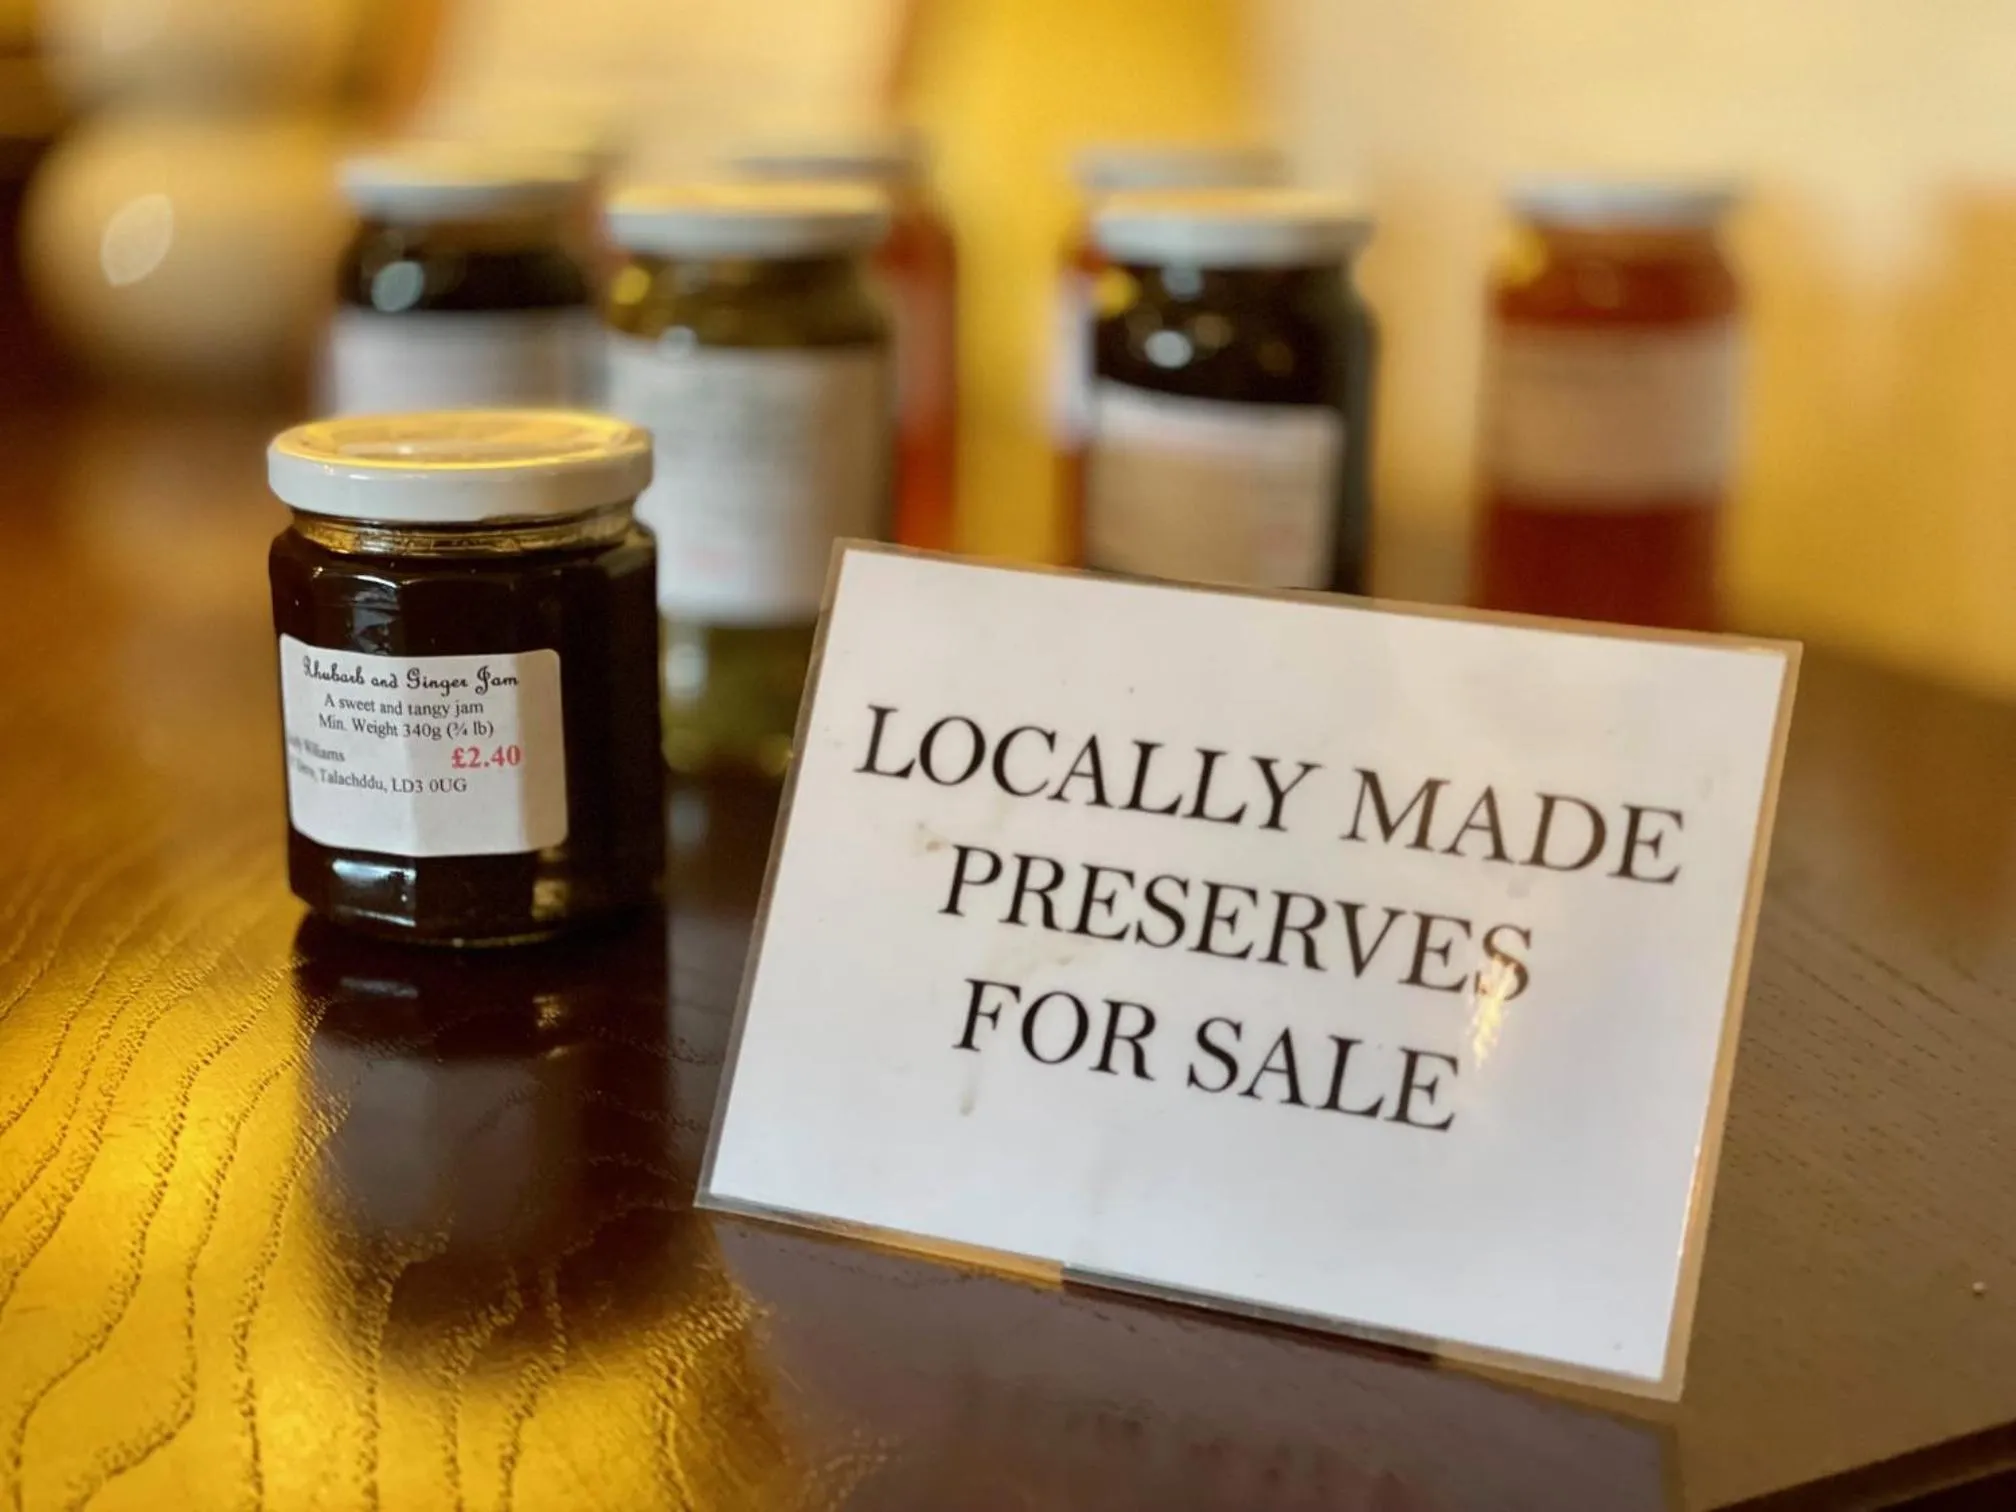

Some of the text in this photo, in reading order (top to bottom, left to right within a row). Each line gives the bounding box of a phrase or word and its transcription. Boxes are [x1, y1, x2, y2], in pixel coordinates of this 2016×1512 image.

[303, 655, 520, 696] Rhubarb and Ginger Jam
[324, 693, 484, 719] A sweet and tangy jam
[319, 713, 347, 731] Min.
[352, 717, 399, 740] Weight
[403, 723, 442, 741] 340g
[473, 720, 494, 739] lb)
[451, 744, 522, 769] £2.40
[391, 778, 424, 794] LD3
[853, 704, 1686, 885] LOCALLY MADE
[937, 844, 1535, 1003] PRESERVES
[952, 977, 1461, 1132] FOR SALE
